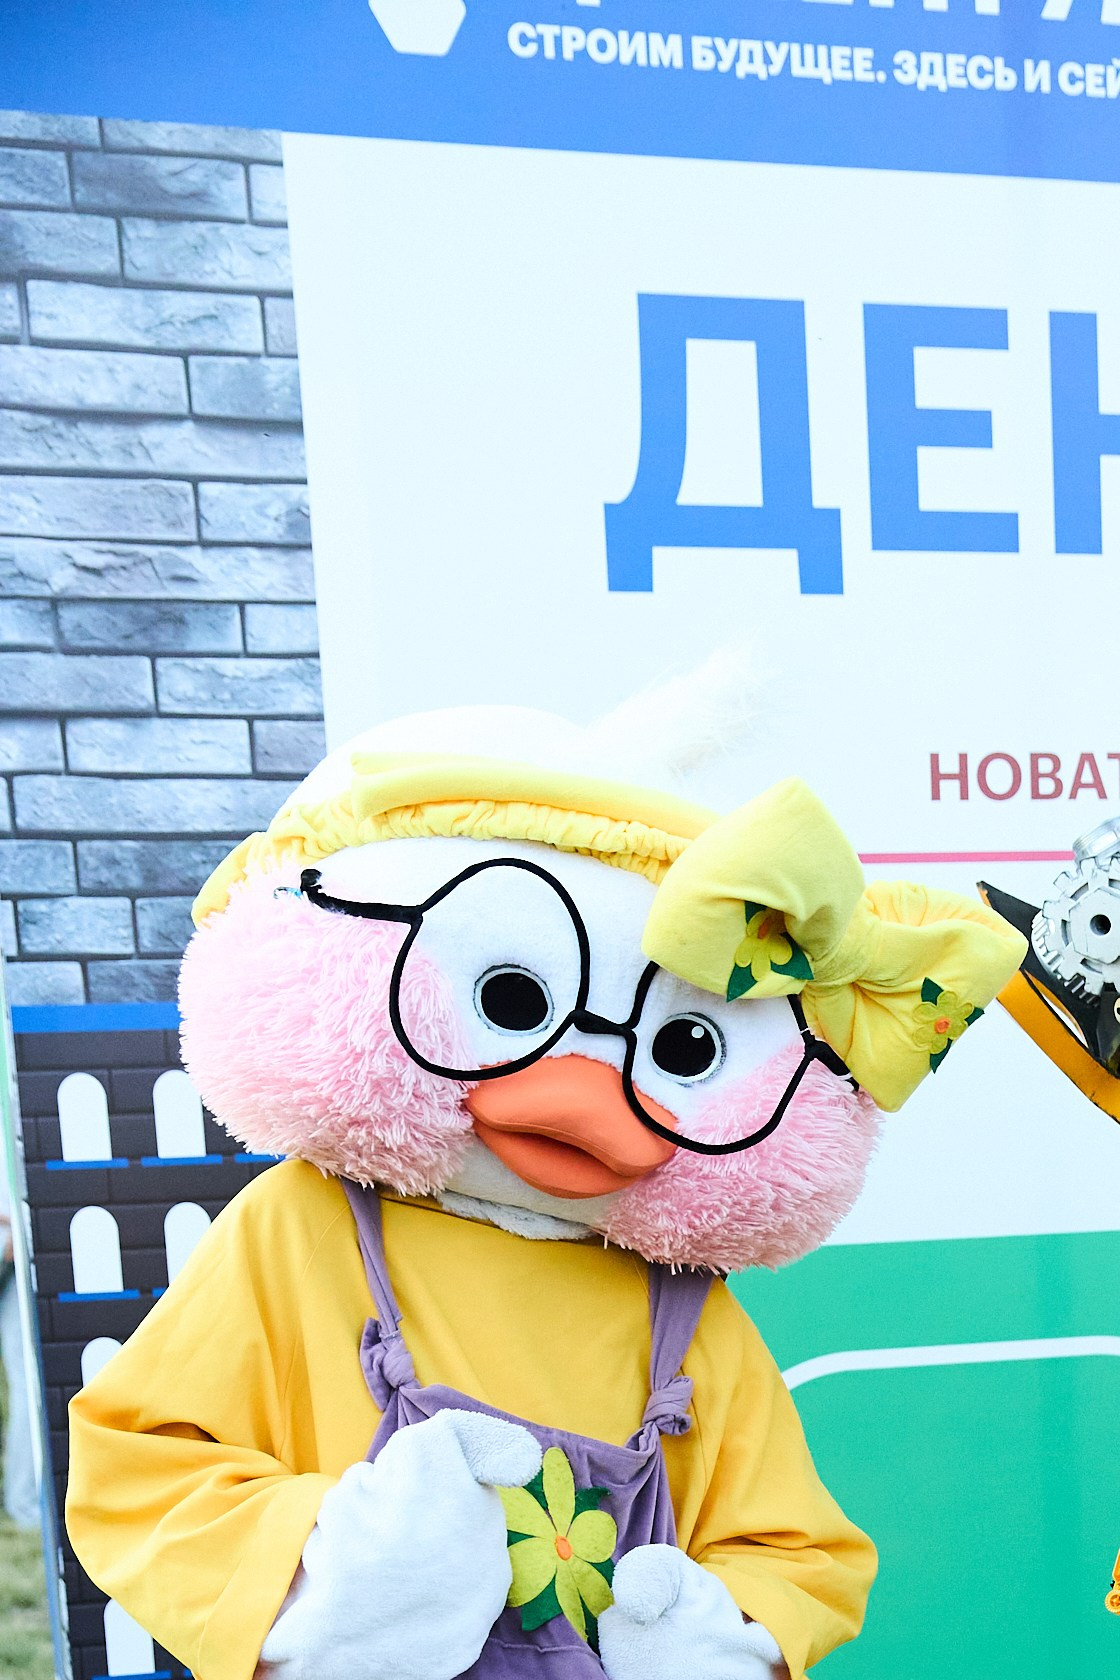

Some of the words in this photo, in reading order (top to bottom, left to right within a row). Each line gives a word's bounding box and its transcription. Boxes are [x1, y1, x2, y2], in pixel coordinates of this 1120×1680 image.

[507, 22, 684, 69] СТРОИМ
[691, 35, 887, 85] БУДУЩЕЕ.
[893, 50, 1018, 93] ЗДЕСЬ
[1023, 58, 1052, 94] И
